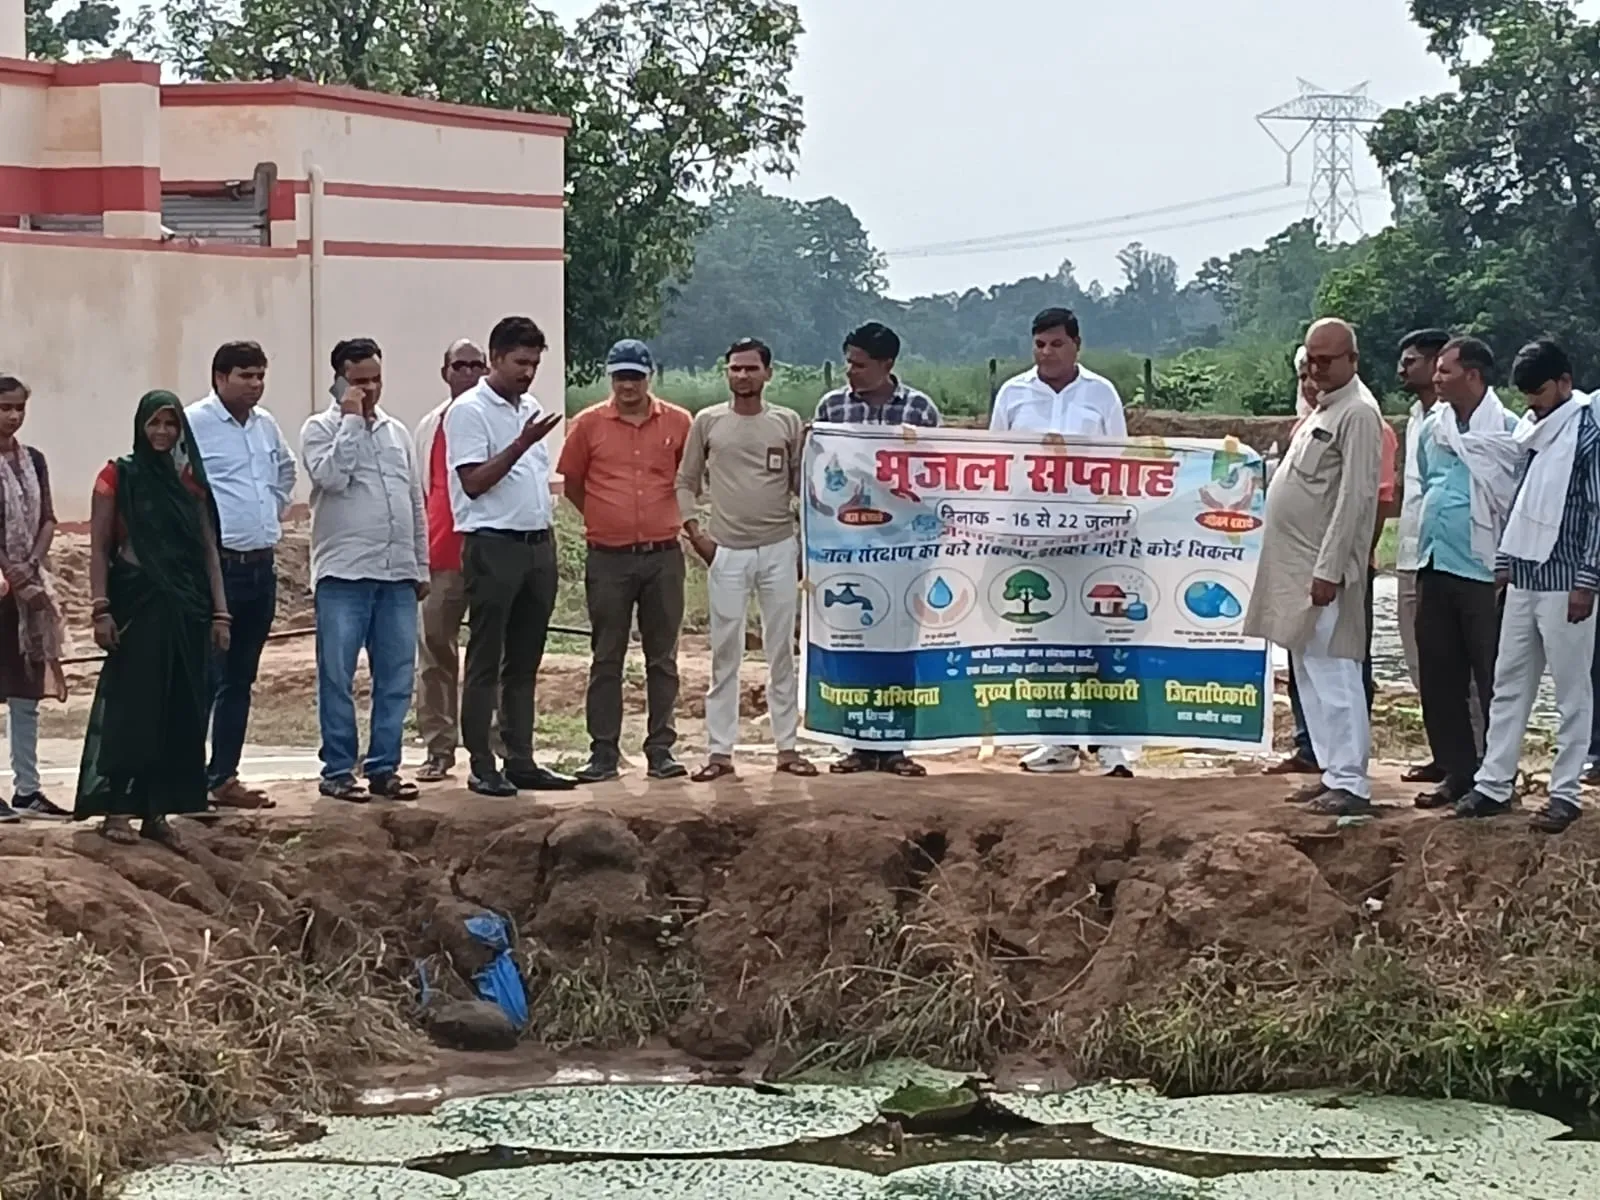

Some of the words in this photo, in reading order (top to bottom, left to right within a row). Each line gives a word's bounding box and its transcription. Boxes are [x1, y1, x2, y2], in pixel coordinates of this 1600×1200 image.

[875, 450, 1013, 502] भूजल
[1024, 455, 1180, 497] सप्ताह
[1013, 512, 1030, 527] 16
[1036, 506, 1051, 528] से
[1058, 513, 1078, 528] 22
[1084, 509, 1132, 531] जुलाई
[919, 543, 942, 558] का
